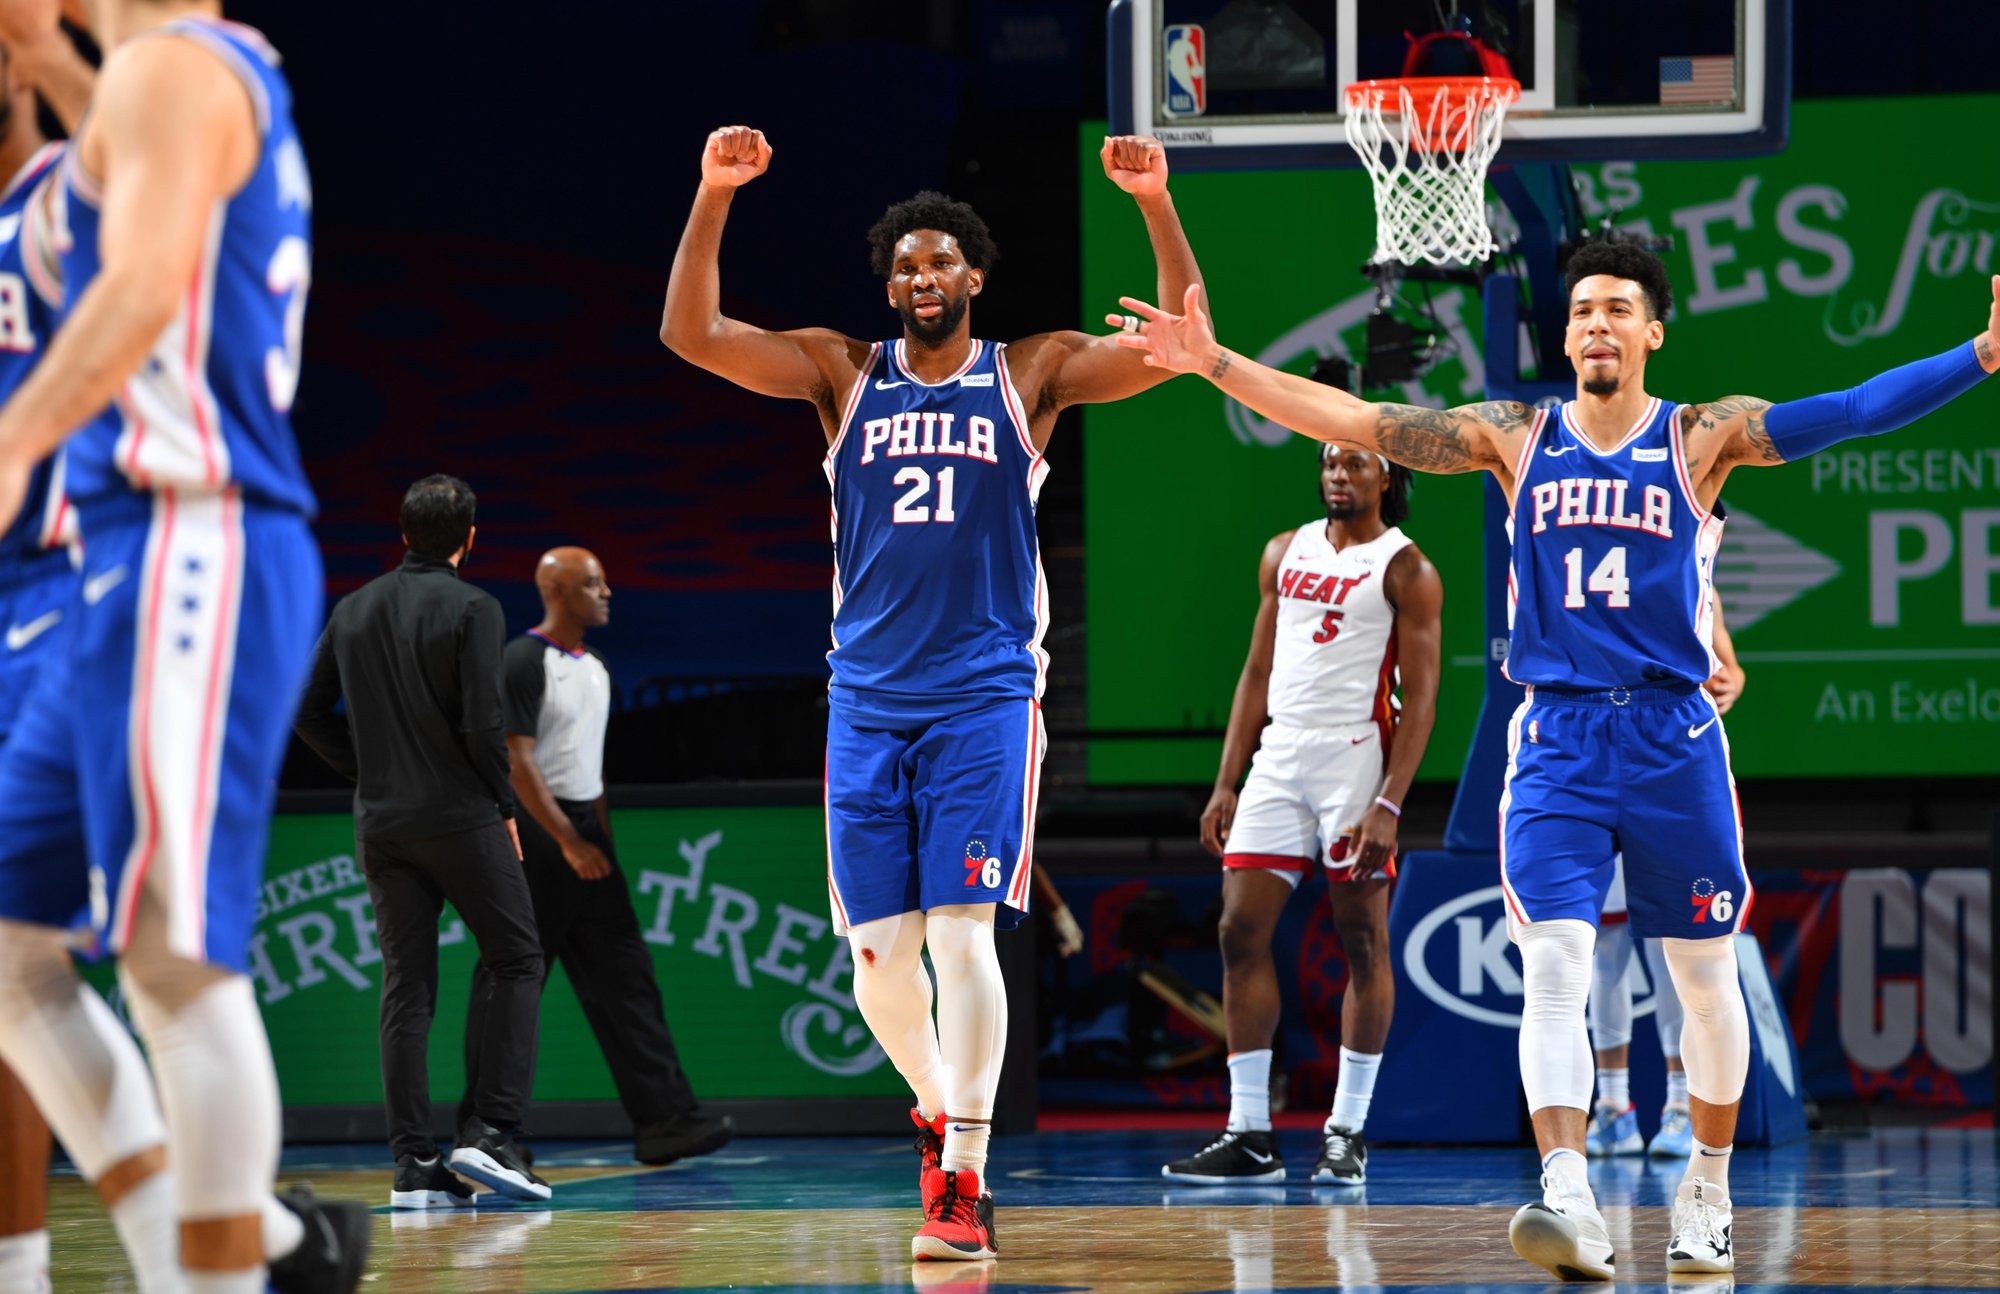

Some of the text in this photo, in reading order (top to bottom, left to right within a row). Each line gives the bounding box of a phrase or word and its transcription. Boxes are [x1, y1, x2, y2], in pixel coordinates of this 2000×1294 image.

[861, 411, 998, 467] PHILA
[892, 466, 955, 524] 21
[1531, 478, 1673, 539] PHILA
[1280, 568, 1371, 606] HEAT
[1563, 546, 1630, 608] 14
[1312, 610, 1344, 644] 5
[1814, 682, 1876, 724] An
[964, 856, 1002, 889] 76
[1691, 889, 1734, 923] 76
